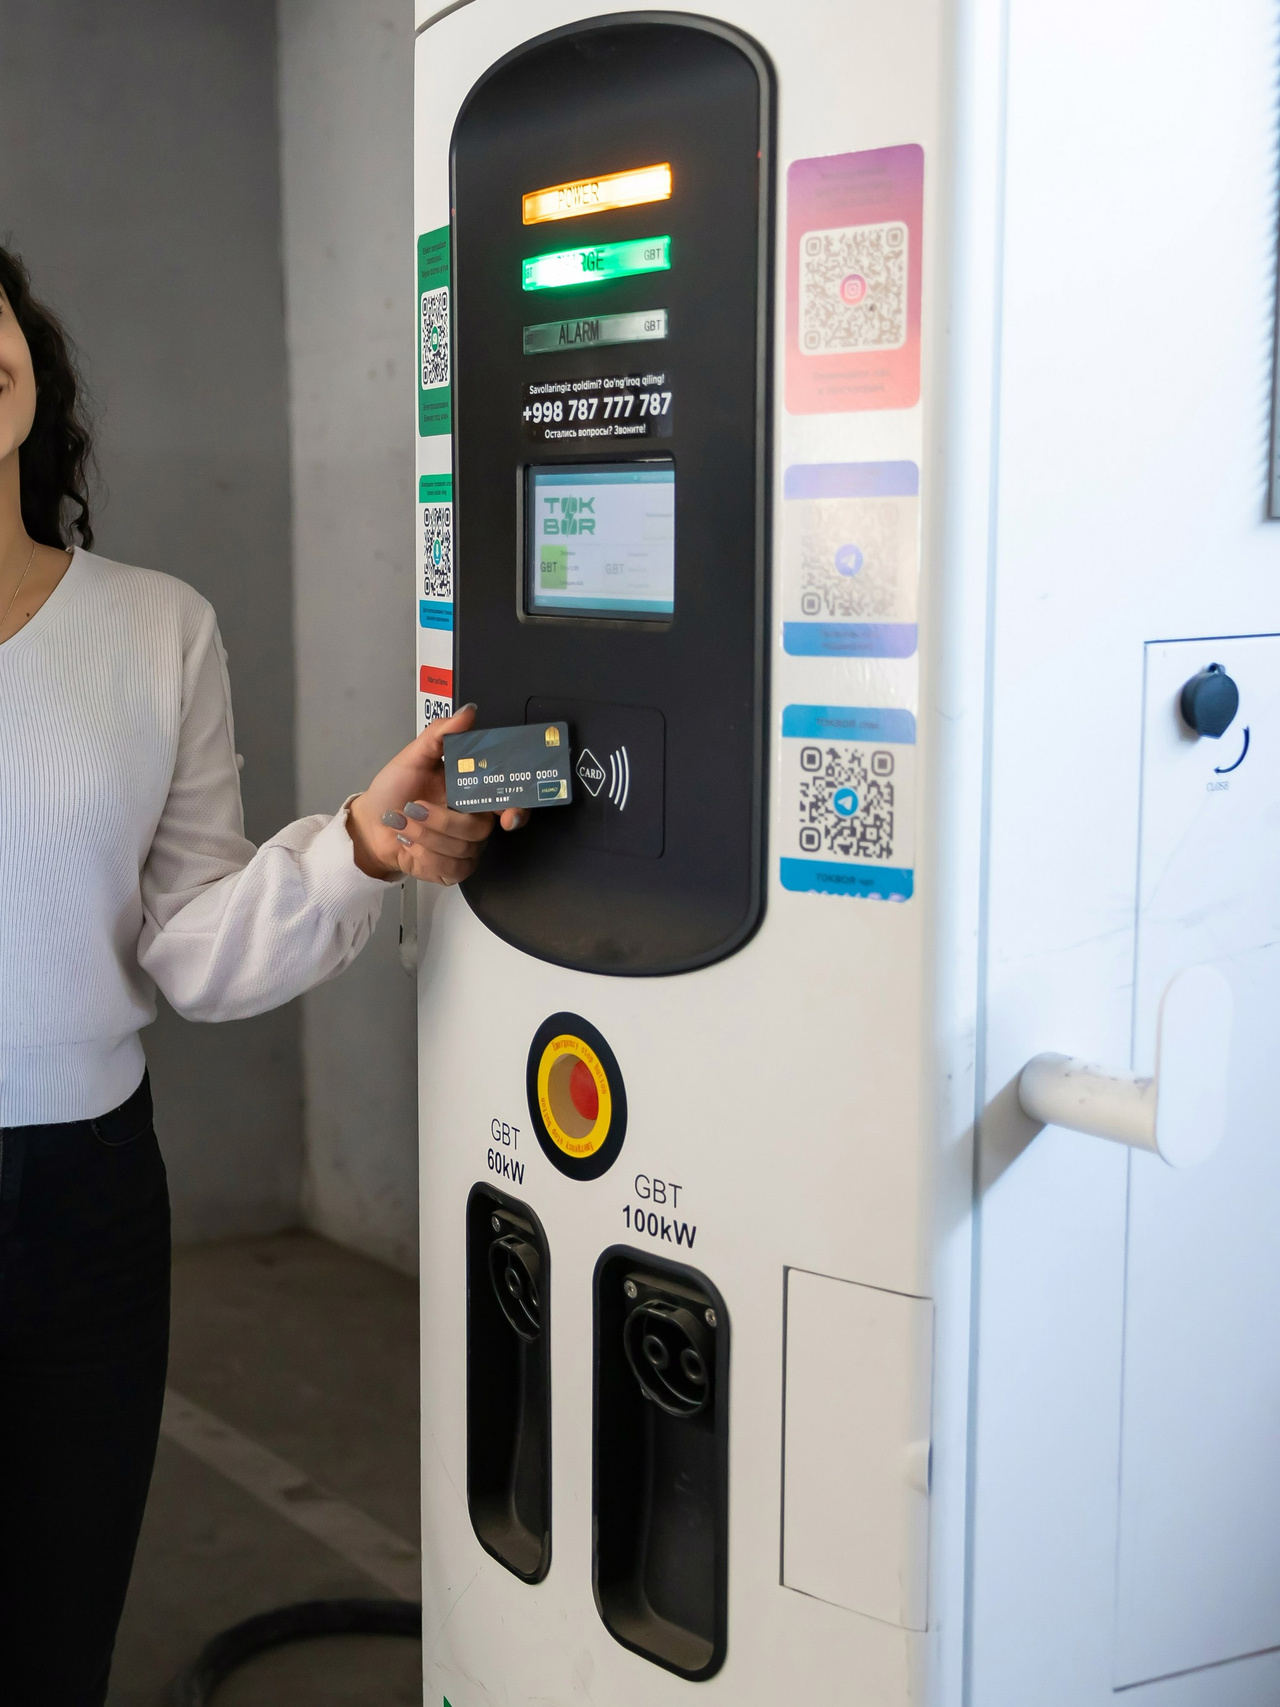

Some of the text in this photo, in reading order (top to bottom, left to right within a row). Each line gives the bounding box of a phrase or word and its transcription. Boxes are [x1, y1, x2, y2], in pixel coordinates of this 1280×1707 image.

[558, 182, 600, 210] POWER
[643, 248, 662, 261] GBT
[558, 320, 600, 346] ALARM
[644, 319, 662, 332] GBT
[529, 379, 572, 395] Savollaringiz
[572, 377, 602, 392] qoldimi?
[641, 373, 665, 387] qiling!
[522, 391, 673, 424] +998 787 777 787
[544, 423, 646, 439] Остались вопросы? Звоните!
[543, 496, 596, 515] TOK
[543, 518, 596, 536] BOR
[540, 561, 558, 573] GBT
[605, 563, 625, 576] GBT
[457, 769, 558, 787] 0000 0000 0000 0000
[579, 766, 602, 780] CARD
[552, 1039, 607, 1095] Emergency stop button
[491, 1118, 521, 1150] GBT
[540, 1097, 594, 1153] Emergency stop button
[487, 1148, 525, 1185] 60kW
[635, 1174, 682, 1208] GBT
[622, 1205, 697, 1249] 100kW
